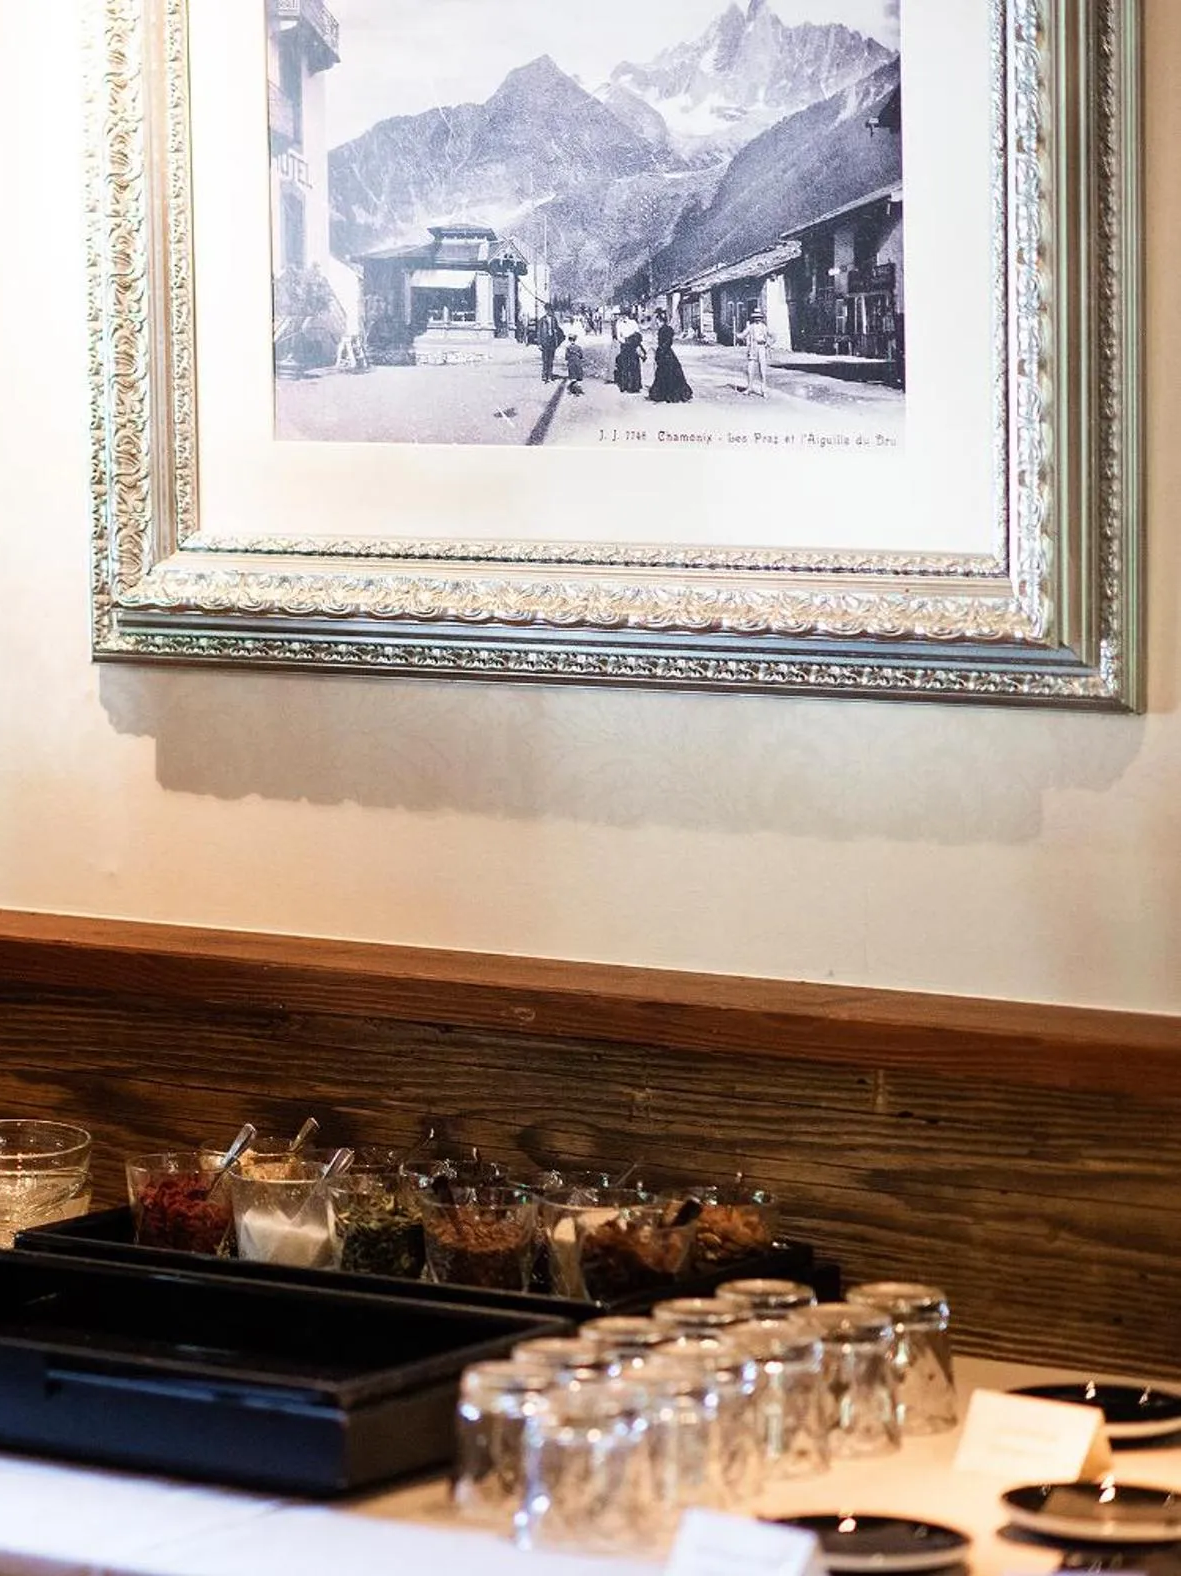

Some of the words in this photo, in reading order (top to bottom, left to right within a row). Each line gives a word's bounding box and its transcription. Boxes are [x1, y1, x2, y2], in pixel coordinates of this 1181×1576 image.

[657, 430, 712, 444] Chamonix
[855, 433, 870, 445] du
[875, 433, 897, 446] Dru
